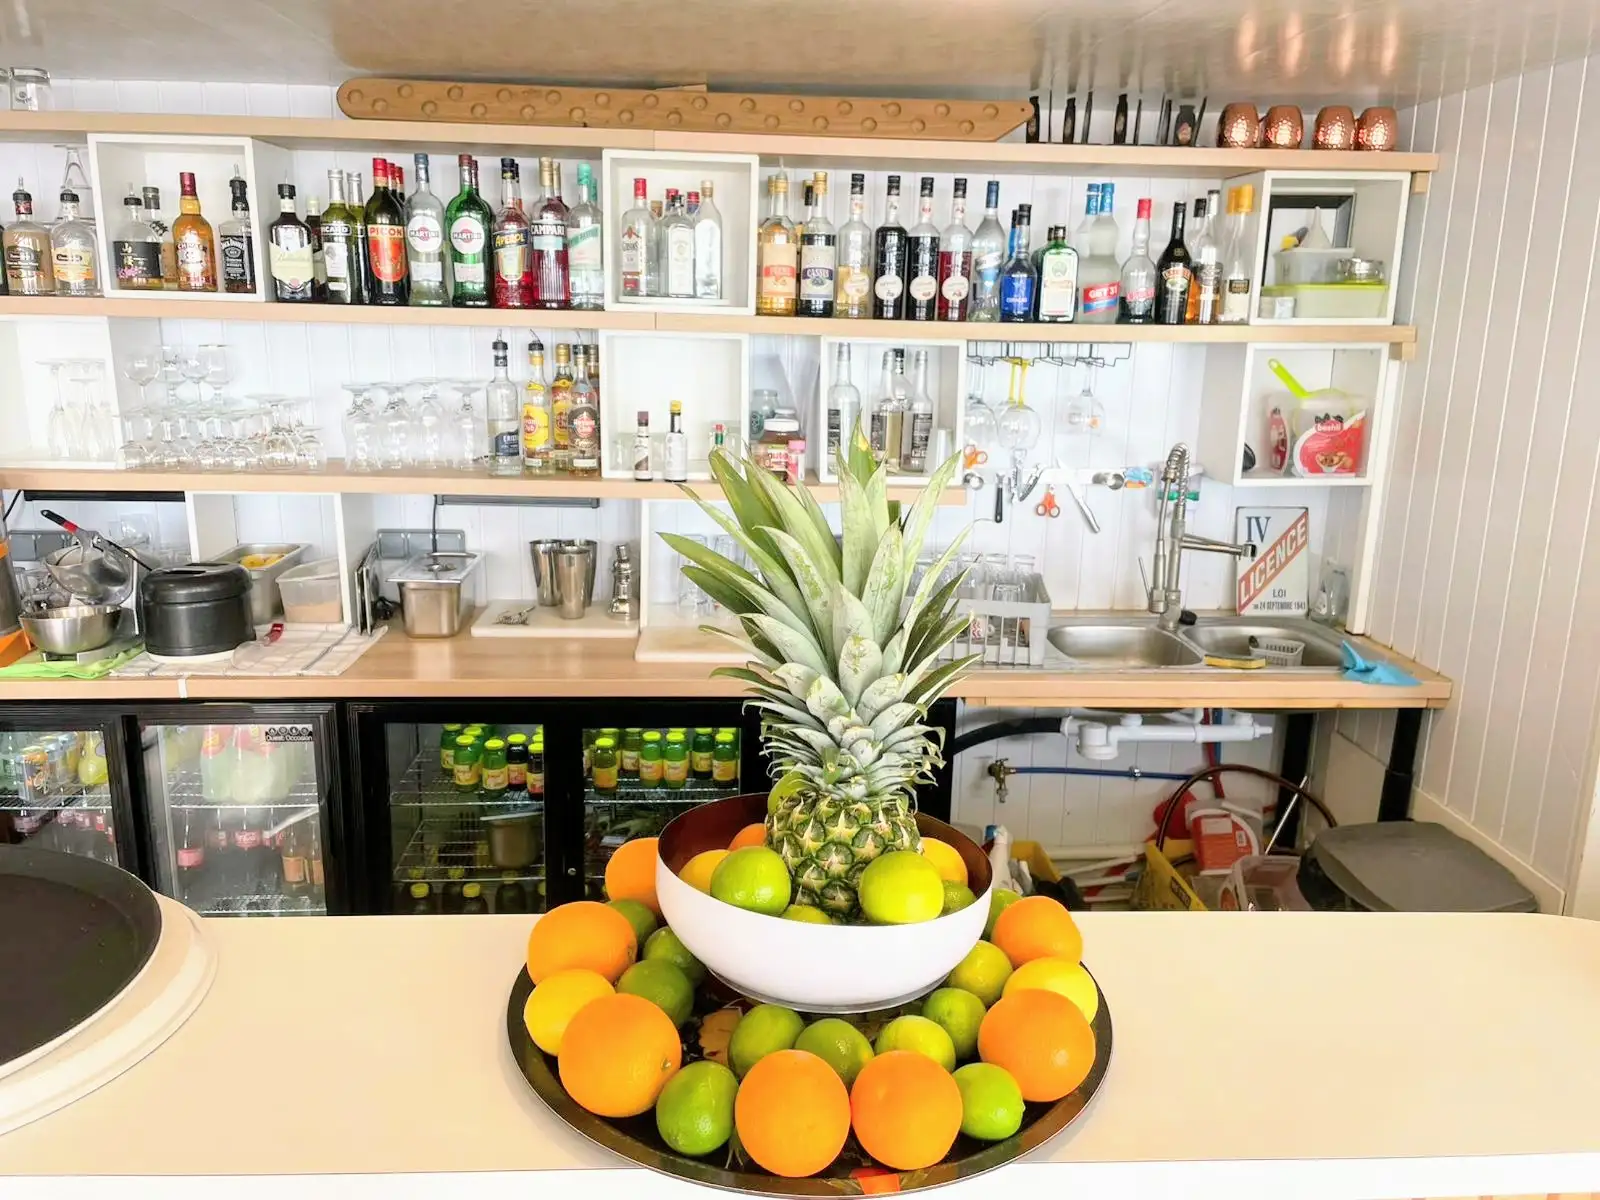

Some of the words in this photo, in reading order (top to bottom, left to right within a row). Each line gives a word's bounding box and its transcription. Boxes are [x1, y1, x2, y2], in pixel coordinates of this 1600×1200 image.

[531, 224, 565, 236] CAMPARI
[452, 232, 482, 240] MARTINI
[495, 234, 526, 246] APEROL
[806, 268, 830, 279] CASSIS
[1246, 516, 1272, 543] IV
[1240, 517, 1306, 605] LICENCE
[1272, 589, 1287, 598] LOI
[1260, 602, 1266, 610] 24
[1266, 601, 1292, 610] SEPTEMBRE
